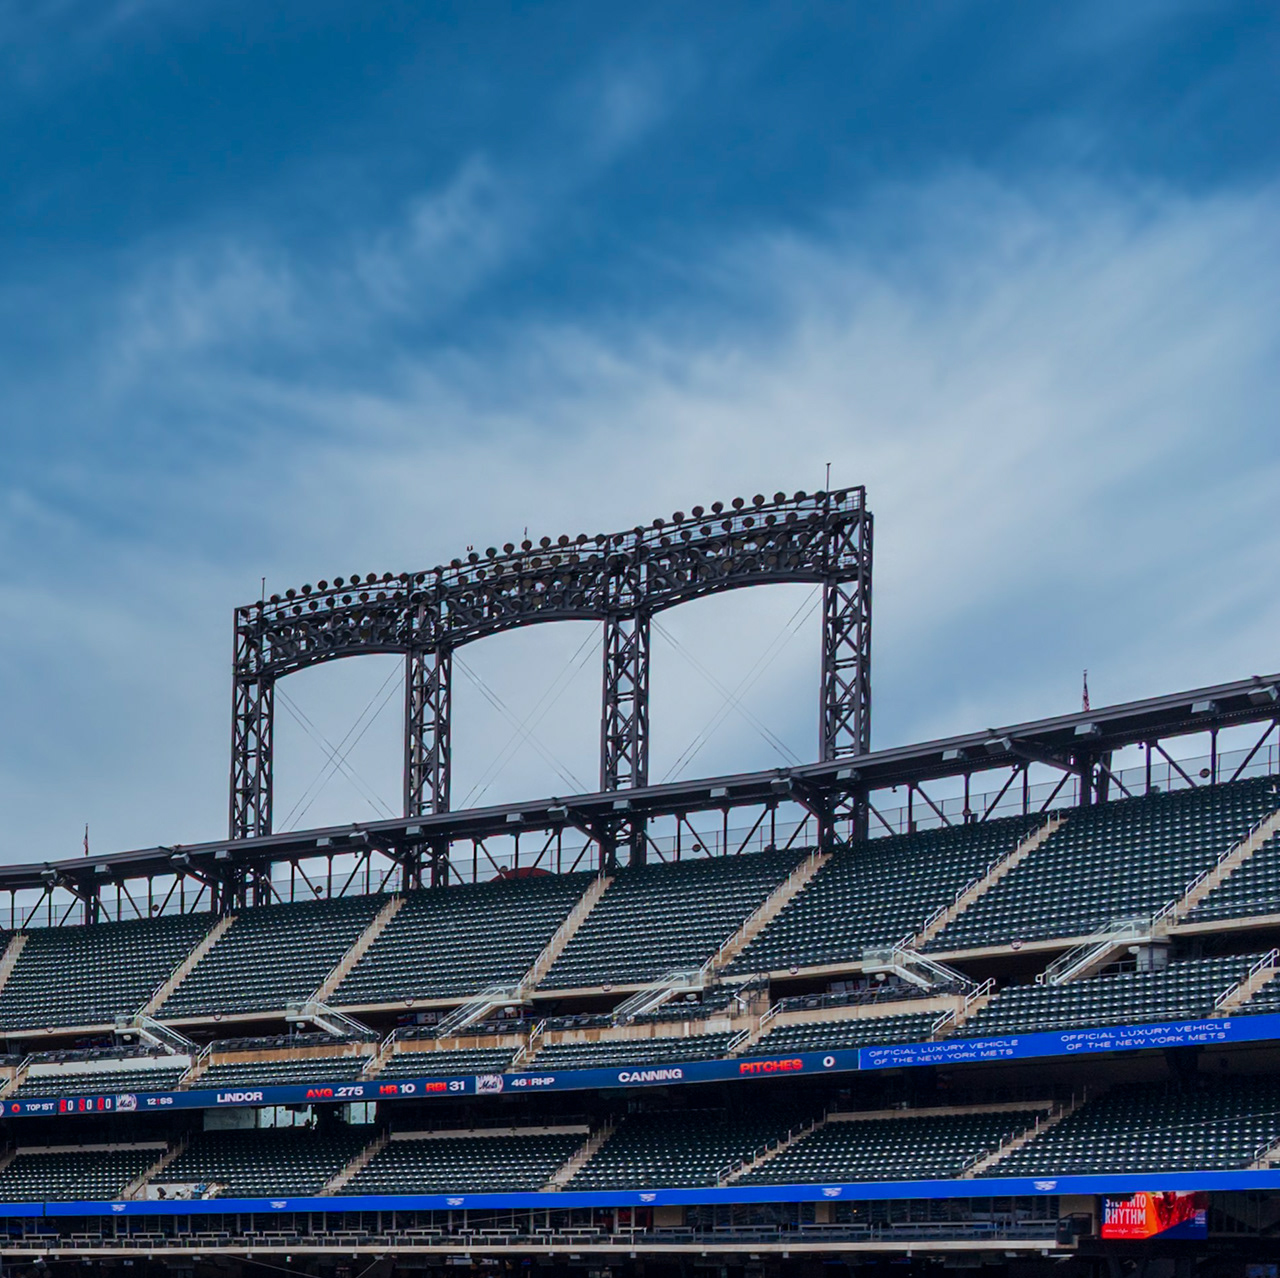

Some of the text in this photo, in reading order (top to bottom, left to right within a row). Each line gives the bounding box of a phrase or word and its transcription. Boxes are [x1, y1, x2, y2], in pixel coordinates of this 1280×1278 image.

[1061, 1022, 1232, 1042] OFFICIAL LUXURY VEHICLE
[869, 1039, 1019, 1058] OFFICIAL LUXURY VEHICLE
[1066, 1032, 1226, 1051] OF THE NEW YORK METS
[917, 1054, 944, 1062] NEW
[947, 1051, 977, 1059] YORK
[980, 1049, 1014, 1057] METS
[739, 1059, 803, 1074] PITCHES
[618, 1068, 682, 1083] CANNING
[217, 1091, 263, 1103] LINDOR
[306, 1081, 465, 1098] AVG .275 HR 10 RBI 31
[26, 1104, 41, 1112] TOP
[1105, 1208, 1146, 1225] RHYTHM
